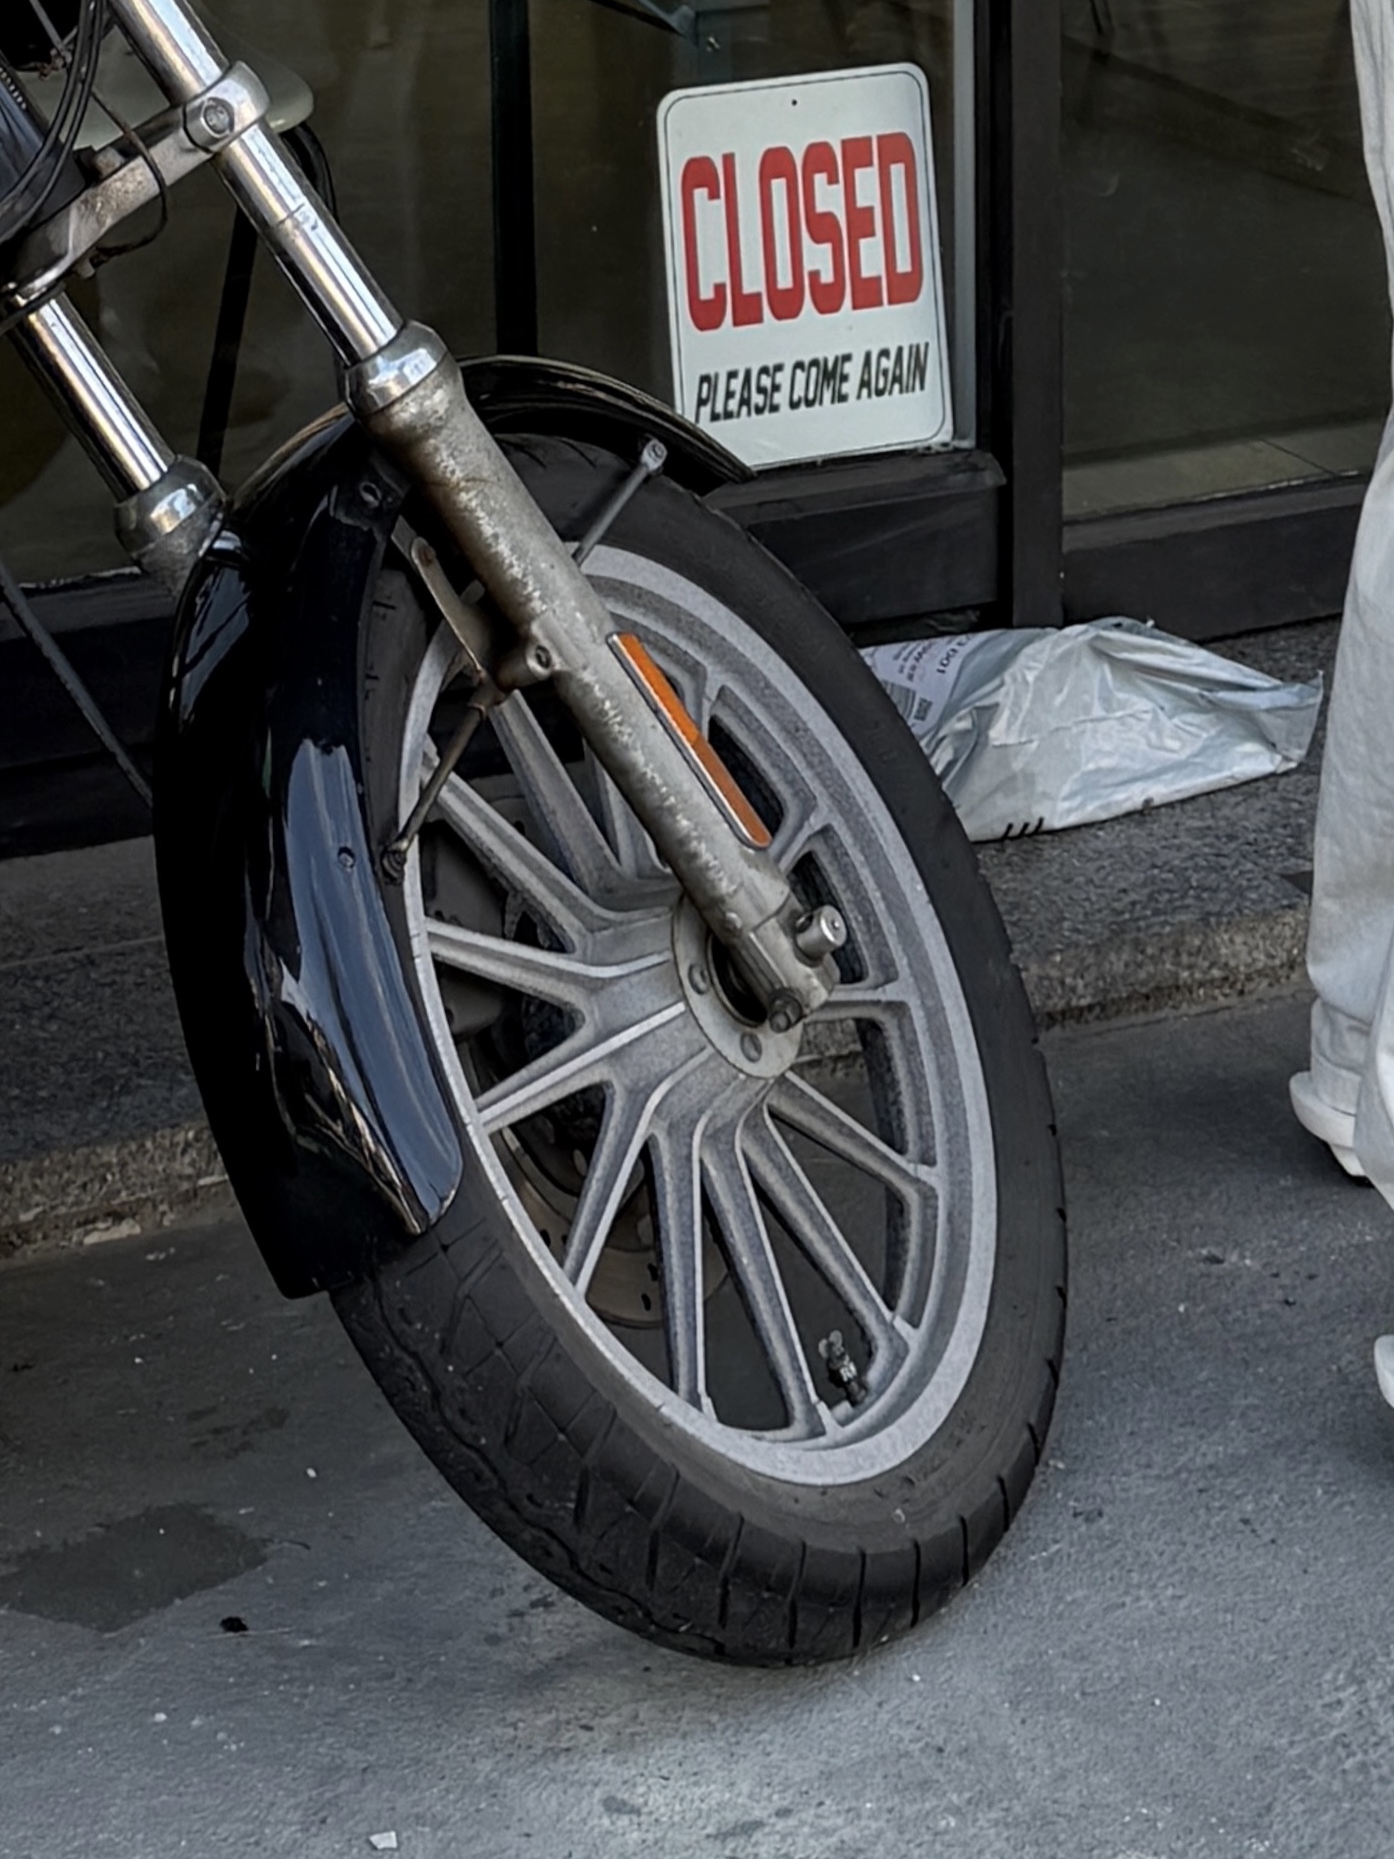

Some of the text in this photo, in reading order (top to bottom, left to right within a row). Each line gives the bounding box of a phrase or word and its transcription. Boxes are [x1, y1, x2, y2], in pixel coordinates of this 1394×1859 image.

[681, 131, 923, 332] CLOSED
[695, 341, 930, 424] PLEASE COME AGAIN
